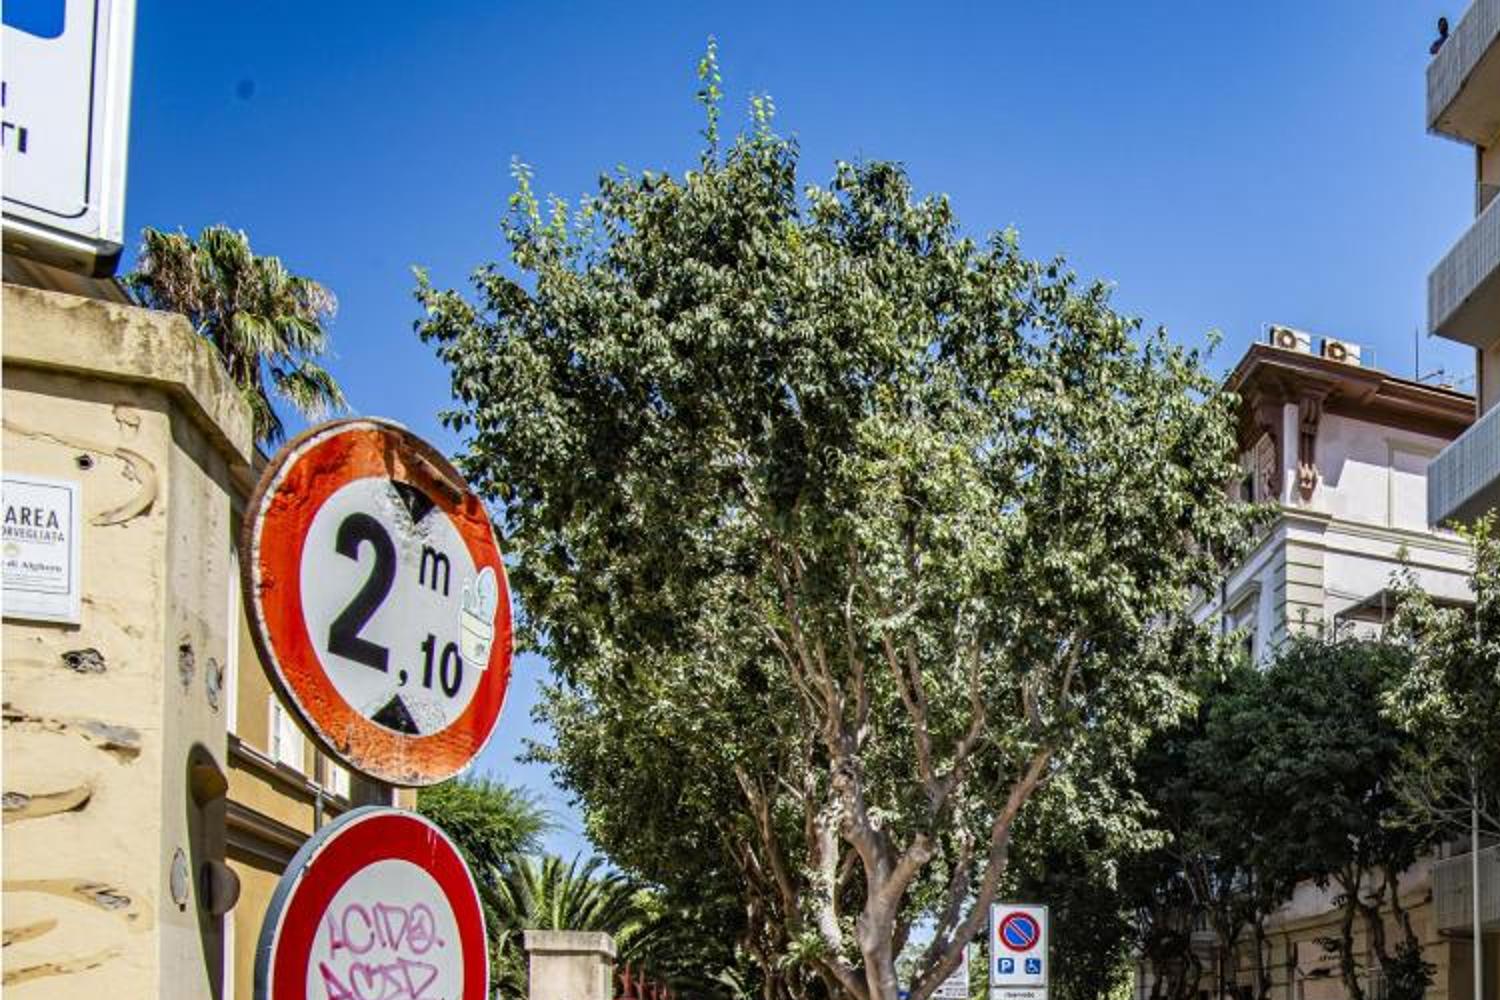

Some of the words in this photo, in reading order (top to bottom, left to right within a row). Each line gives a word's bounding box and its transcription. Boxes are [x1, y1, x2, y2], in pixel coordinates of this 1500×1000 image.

[5, 505, 59, 529] AREA
[327, 511, 397, 674] 2
[418, 544, 451, 597] m
